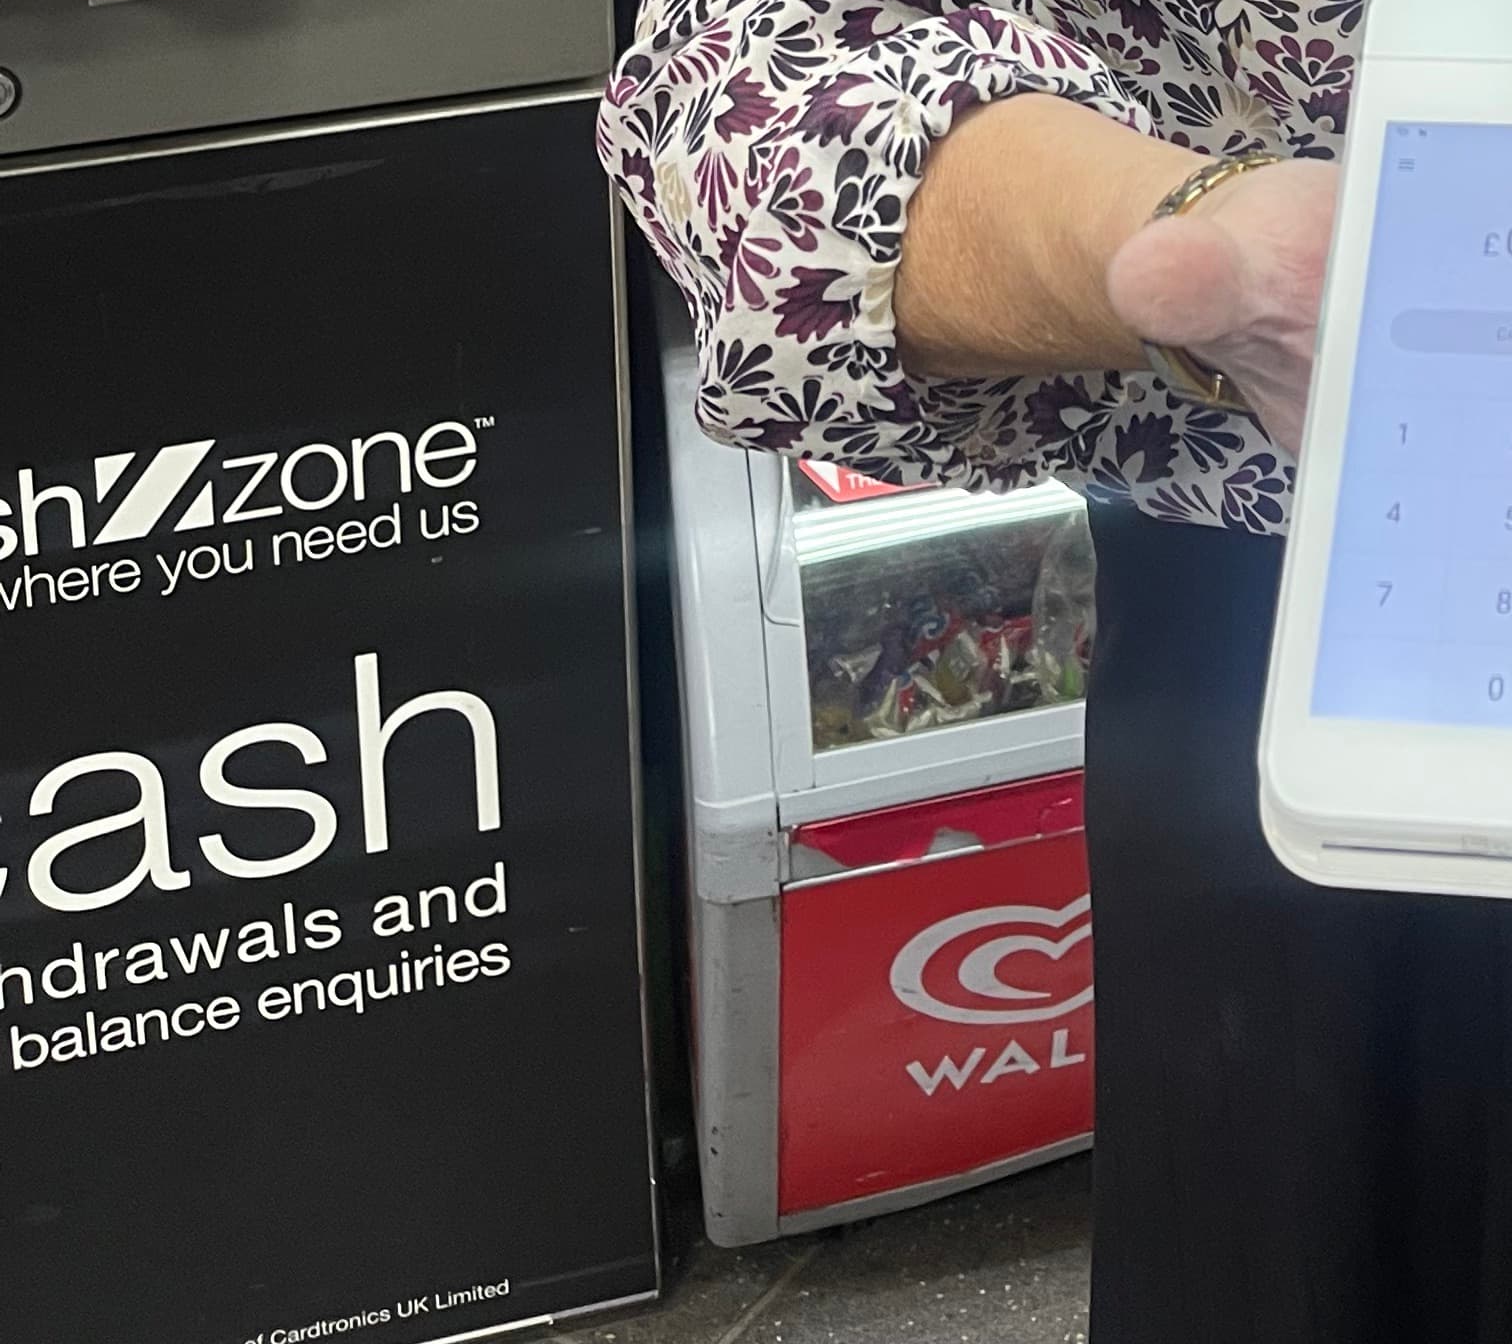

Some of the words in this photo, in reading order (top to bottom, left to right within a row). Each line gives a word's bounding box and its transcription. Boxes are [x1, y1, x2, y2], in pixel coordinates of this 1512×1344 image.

[1399, 423, 1408, 445] 1
[1386, 502, 1401, 524] 4
[159, 541, 254, 595] you
[272, 503, 401, 567] need
[419, 498, 480, 538] us
[1376, 581, 1393, 608] 7
[1496, 590, 1512, 615] 8
[1488, 676, 1504, 702] 0
[0, 652, 501, 914] ash
[372, 862, 507, 938] and
[9, 991, 240, 1070] balance
[257, 939, 511, 1021] enquiries
[270, 1306, 391, 1344] Cardtronics
[397, 1296, 429, 1318] UK
[435, 1279, 510, 1310] Limited
